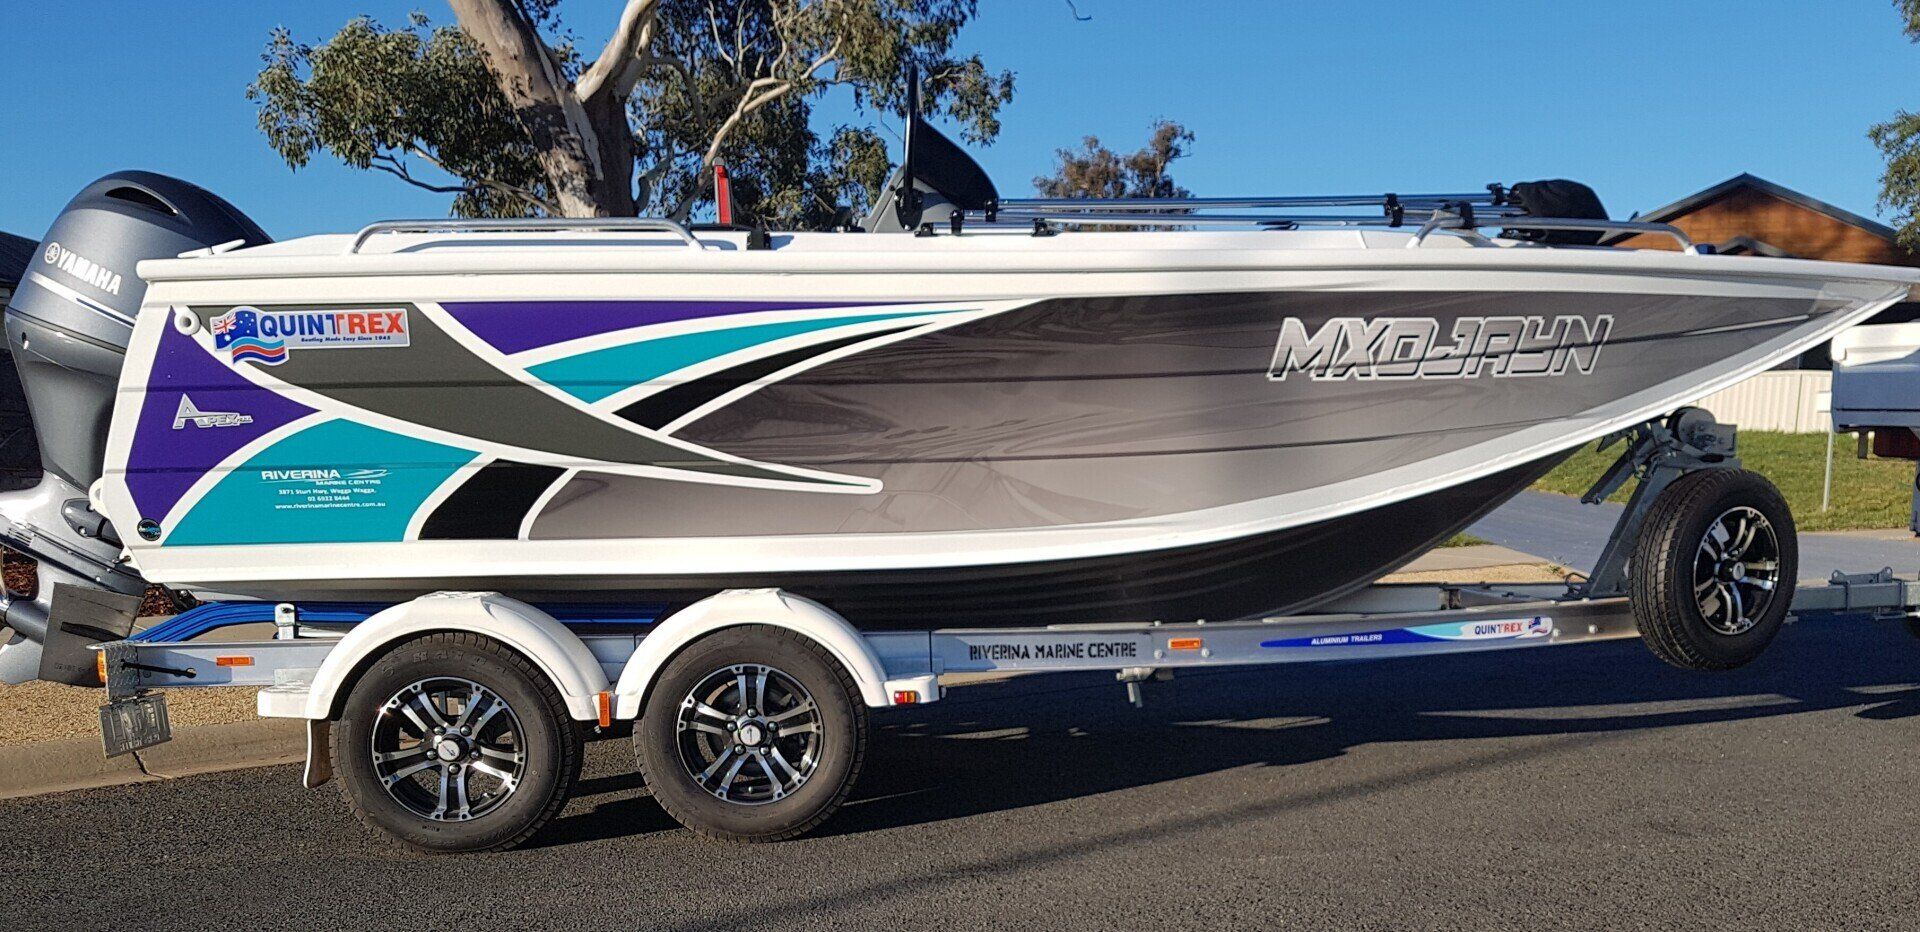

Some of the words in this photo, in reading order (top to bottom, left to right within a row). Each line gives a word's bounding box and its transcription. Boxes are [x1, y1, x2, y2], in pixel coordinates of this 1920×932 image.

[57, 247, 122, 295] YAMAHA
[260, 312, 404, 338] QUINTREX
[261, 469, 341, 480] RIVERINA
[330, 487, 352, 495] Wagga
[1474, 622, 1523, 635] QUINTREX
[1311, 635, 1349, 645] ALUMINIUM
[1351, 633, 1383, 643] TRAILERS
[969, 644, 1031, 661] RIVERINA
[1035, 642, 1084, 659] MARINE
[1087, 642, 1137, 658] CENTRE
